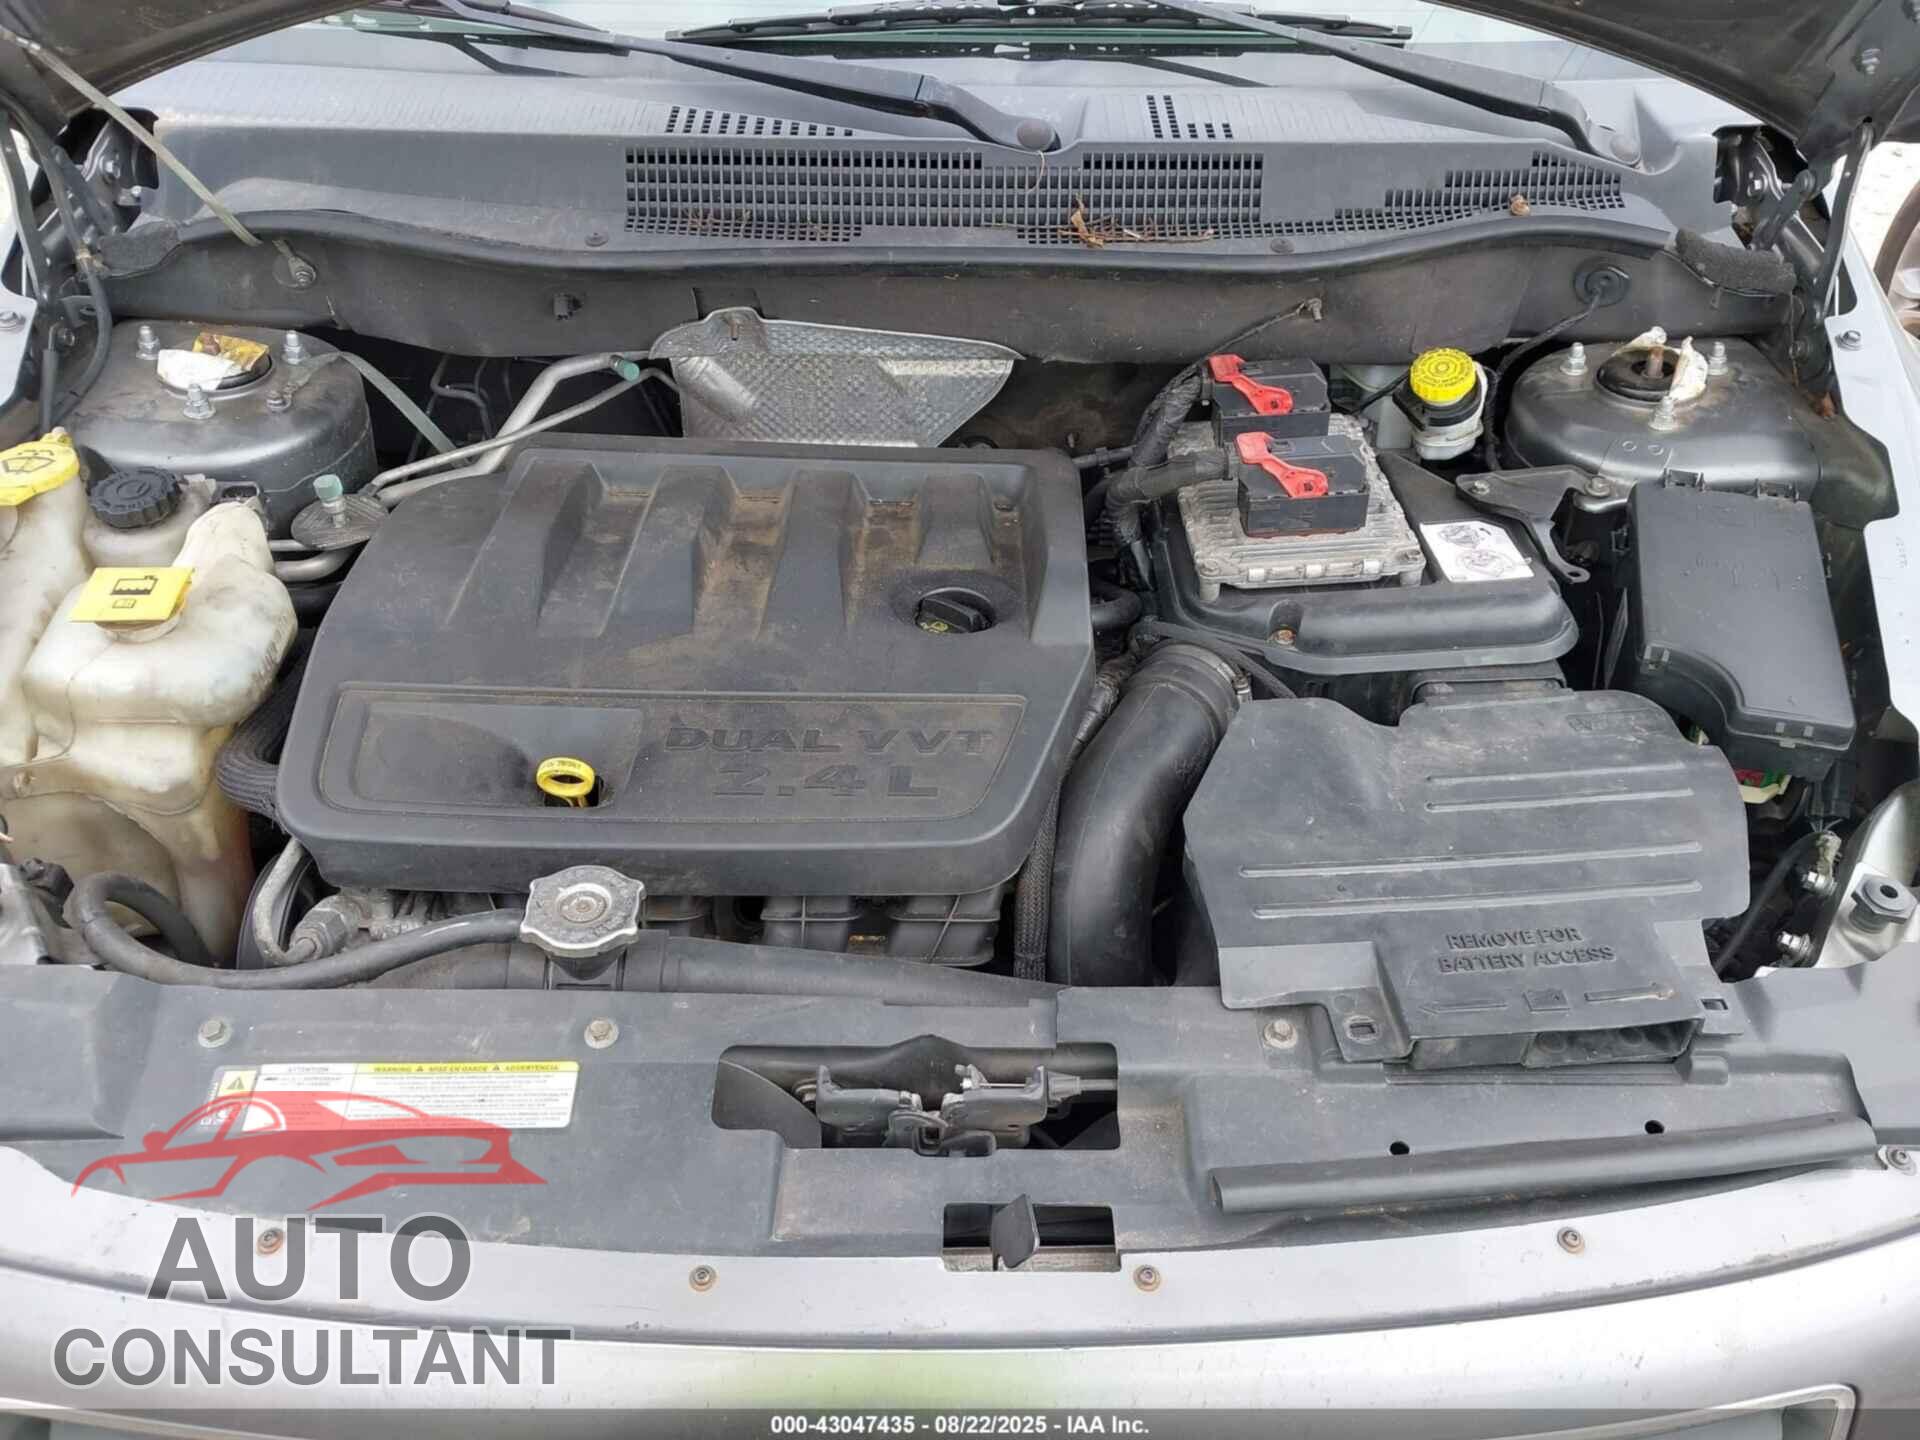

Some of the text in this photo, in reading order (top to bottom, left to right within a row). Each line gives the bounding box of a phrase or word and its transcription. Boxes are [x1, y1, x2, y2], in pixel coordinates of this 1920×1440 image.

[664, 726, 994, 754] DUAL VVT
[1446, 926, 1584, 950] REMOVE FOR
[1437, 945, 1617, 974] BATTERY ACCESS
